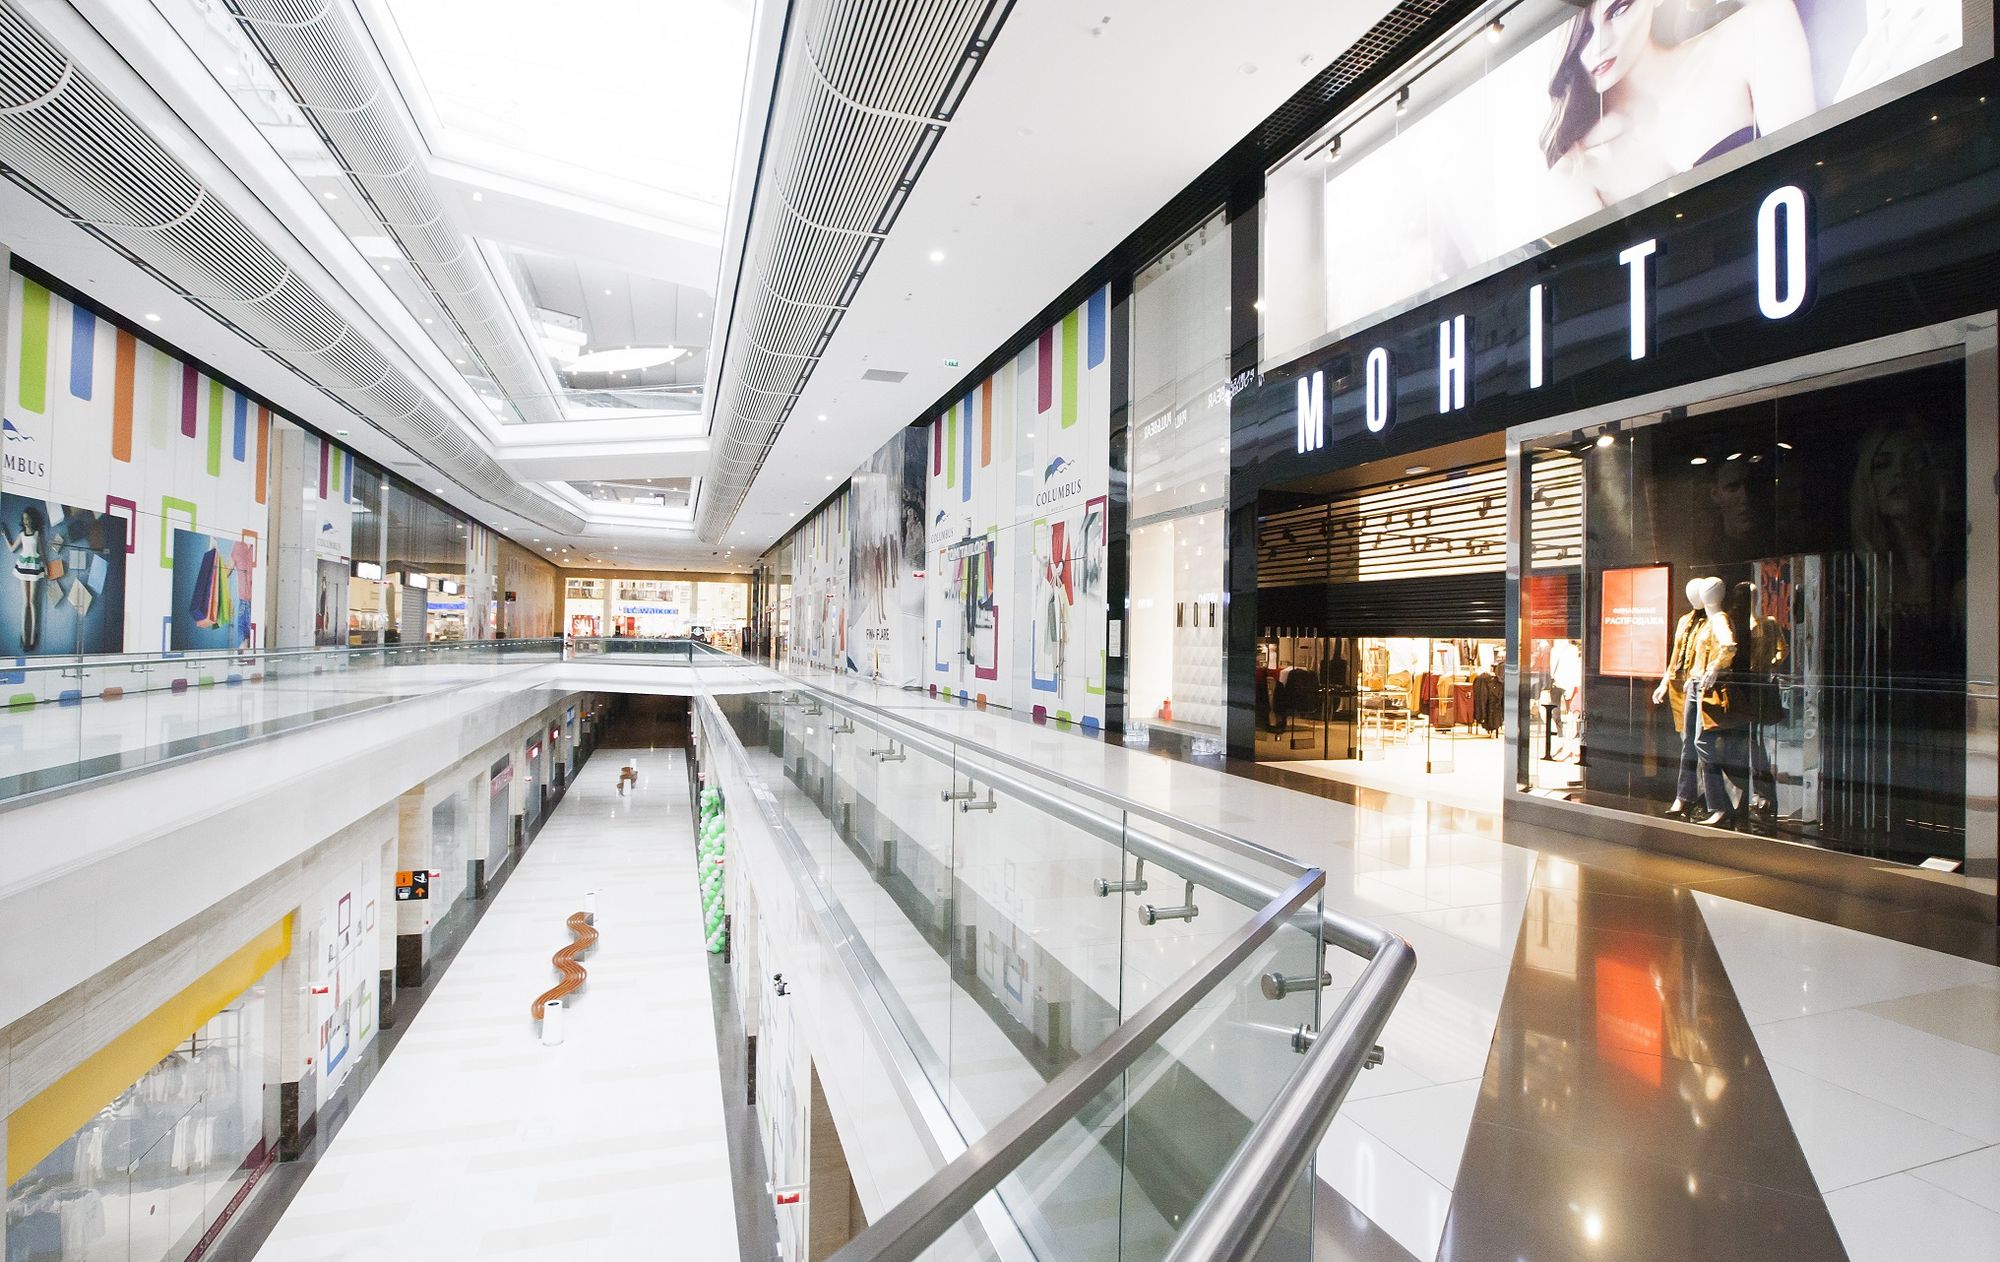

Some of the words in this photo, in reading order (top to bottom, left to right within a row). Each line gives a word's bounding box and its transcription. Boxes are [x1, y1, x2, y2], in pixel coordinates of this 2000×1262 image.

[1297, 185, 1808, 454] MOHITO
[1035, 479, 1082, 507] COLUMBUS
[1604, 616, 1665, 626] РАСПРОДАЖА
